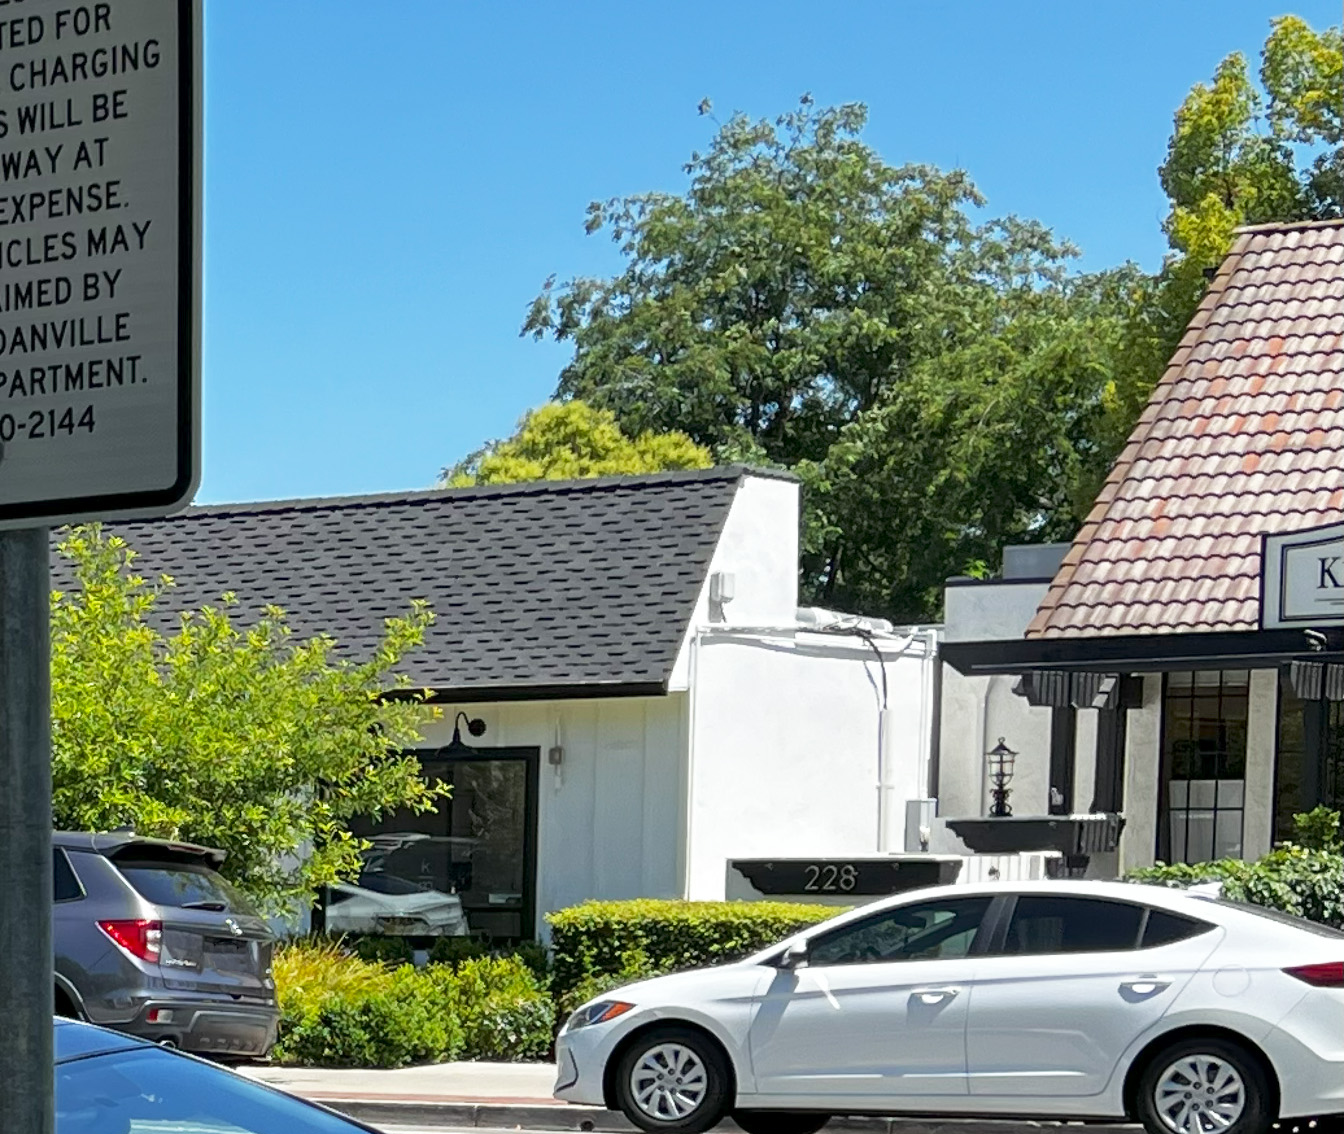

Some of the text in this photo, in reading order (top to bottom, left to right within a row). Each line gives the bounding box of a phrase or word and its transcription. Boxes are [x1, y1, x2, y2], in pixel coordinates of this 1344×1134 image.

[56, 3, 111, 40] FOR
[10, 39, 160, 92] CHARGING
[17, 98, 82, 135] WILL
[92, 89, 128, 123] BE
[73, 137, 109, 171] AT
[88, 220, 151, 257] MAY
[83, 268, 122, 302] BY
[804, 864, 857, 891] 228
